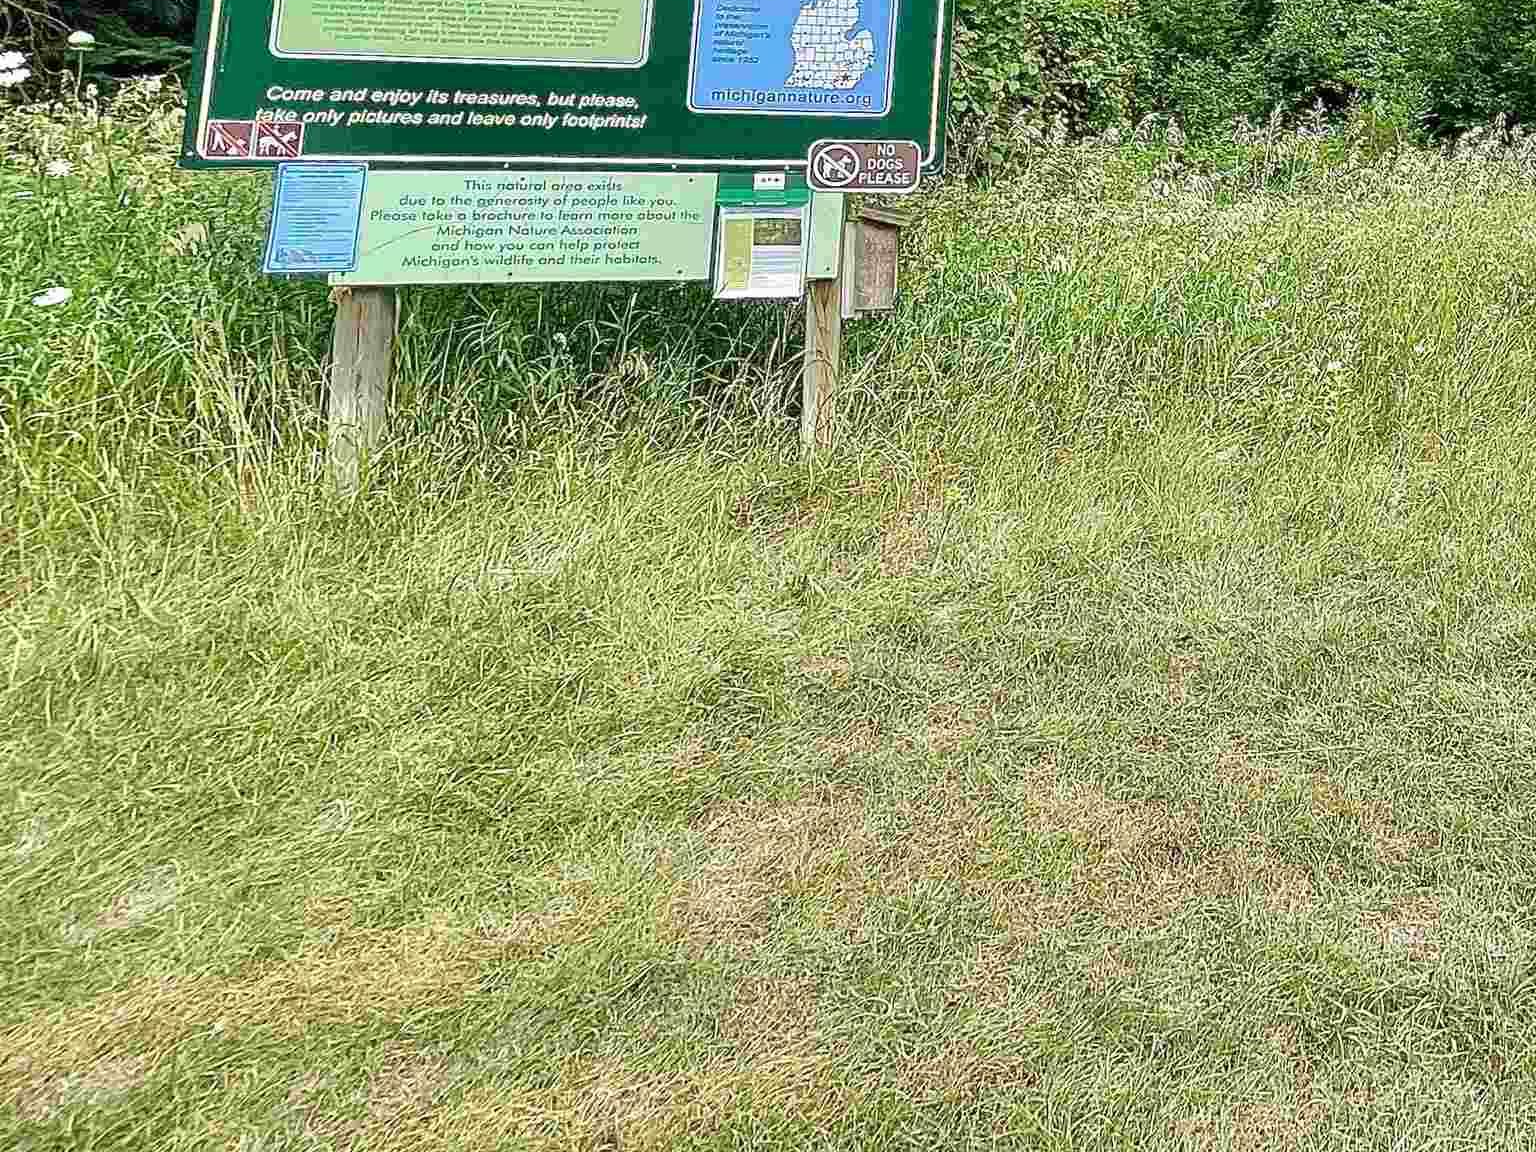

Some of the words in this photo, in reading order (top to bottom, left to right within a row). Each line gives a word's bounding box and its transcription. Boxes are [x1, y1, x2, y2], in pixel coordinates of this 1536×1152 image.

[266, 86, 324, 101] Come
[330, 88, 368, 101] and
[371, 89, 423, 106] enjoy
[426, 90, 449, 104] its
[453, 91, 541, 108] treasures,
[547, 92, 575, 106] but
[578, 93, 640, 110] please,
[711, 88, 872, 107] michigannature.org
[255, 108, 297, 122] take
[302, 109, 345, 127] only
[347, 110, 423, 126] pictures
[427, 112, 464, 126] and
[467, 112, 516, 126] leave
[520, 112, 559, 130] only
[562, 113, 648, 130] footprints!
[877, 144, 895, 155] NO
[867, 158, 904, 170] DOGS
[464, 179, 492, 191] This
[496, 180, 546, 192] natural
[551, 182, 583, 192] area
[587, 179, 623, 192] exists
[858, 173, 912, 185] PLEASE
[400, 195, 427, 206] due
[432, 196, 445, 206] to
[450, 195, 472, 206] the
[477, 195, 549, 209] generosity
[553, 195, 567, 206] of
[571, 195, 618, 209] people
[623, 195, 645, 206] like
[370, 210, 417, 221] Please
[422, 210, 453, 221] take
[457, 212, 467, 221] a
[472, 210, 536, 221] brochure
[540, 211, 553, 221] to
[558, 210, 593, 221] learn
[598, 212, 633, 221] more
[638, 210, 676, 221] about
[680, 210, 702, 221] the
[436, 225, 503, 238] Michigan
[508, 225, 558, 236] Nature
[561, 225, 638, 236] Association
[431, 240, 460, 251] and
[465, 240, 495, 251] how
[499, 241, 524, 252] you
[529, 241, 554, 250] can
[559, 240, 589, 252] help
[593, 240, 640, 252] protect
[401, 256, 480, 268] Michigan's
[484, 255, 534, 266] wildlife
[538, 255, 566, 265] and
[569, 255, 600, 265] their
